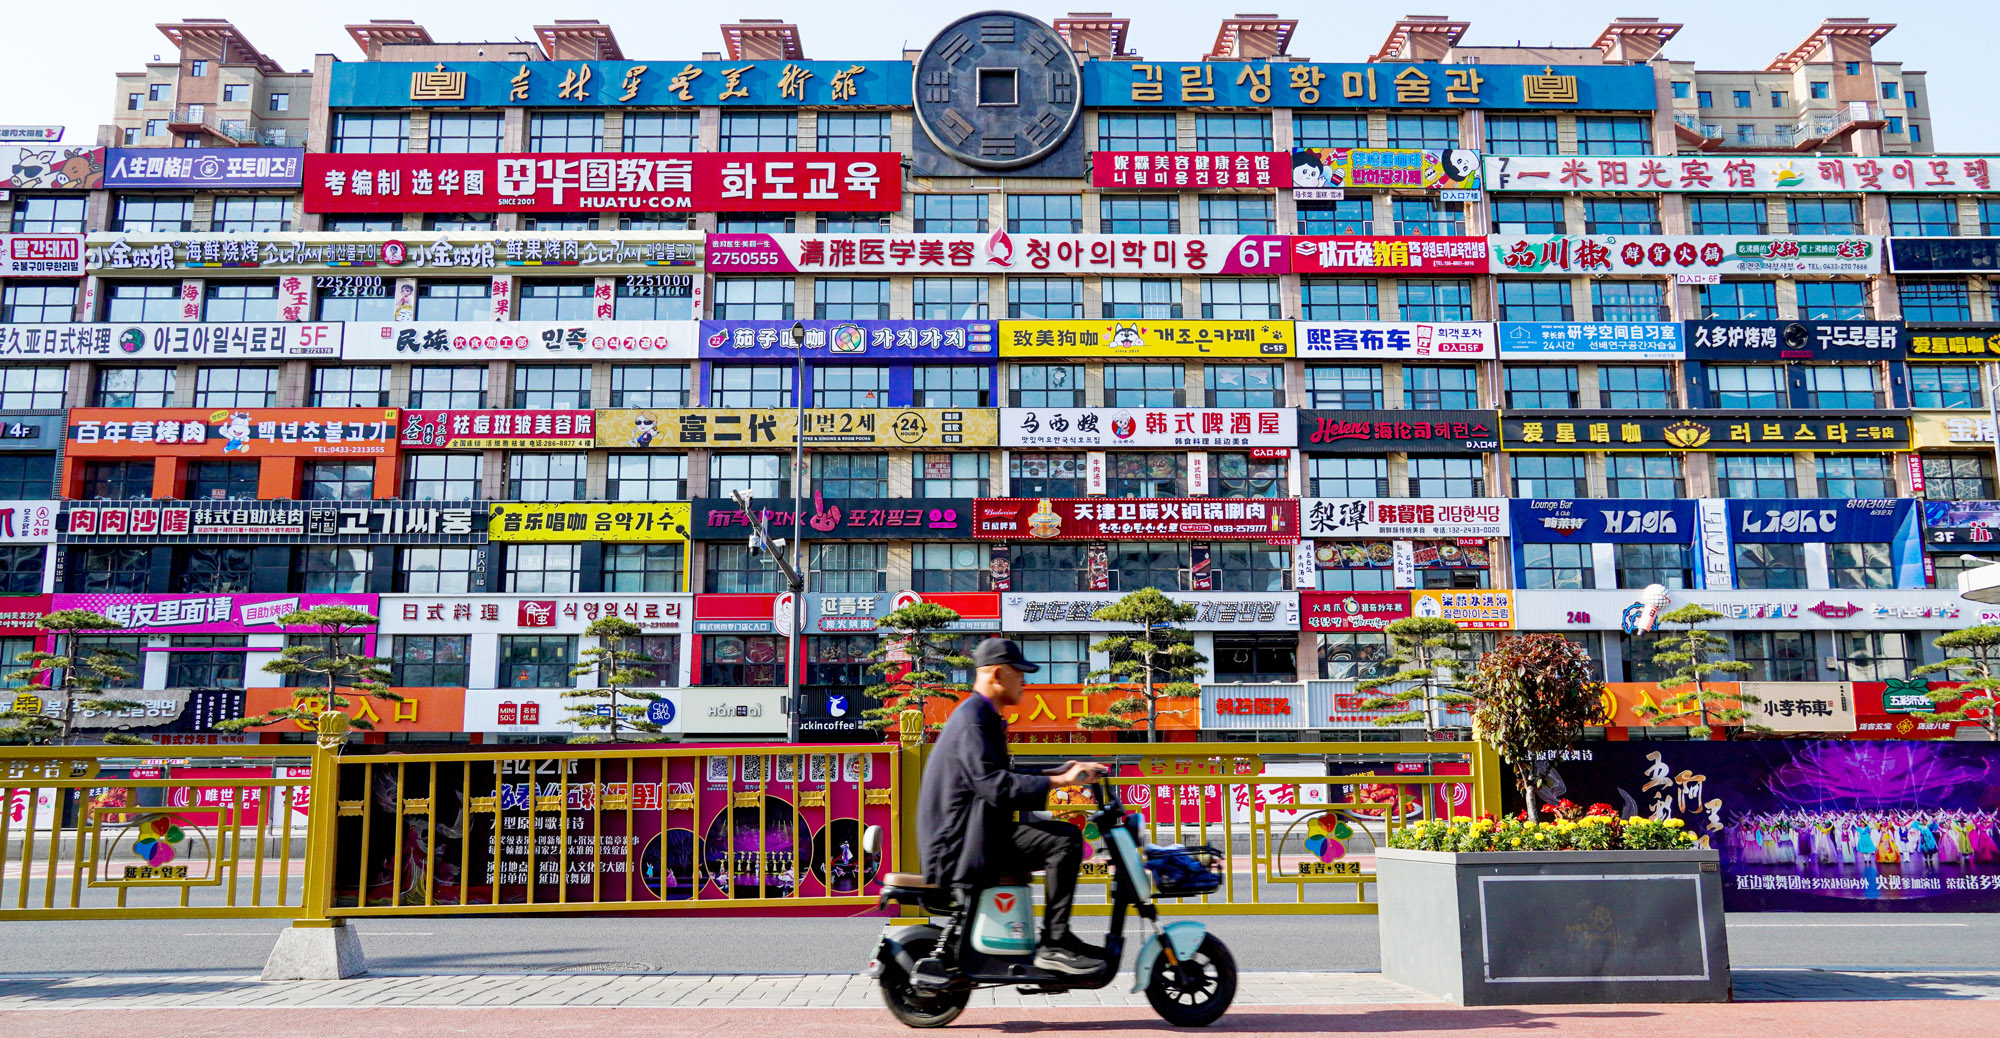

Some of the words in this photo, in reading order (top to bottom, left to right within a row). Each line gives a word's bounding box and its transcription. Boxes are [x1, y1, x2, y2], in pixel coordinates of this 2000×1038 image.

[1130, 63, 1484, 104] 길림성황미술관
[111, 157, 182, 179] 人生四格
[226, 157, 286, 178] 포토이즈
[1352, 169, 1422, 186] 반하당카페
[1517, 159, 1756, 189] 一米阳光宾馆
[1818, 159, 1991, 190] 해맞이모텔
[325, 168, 400, 196] 考编制
[412, 168, 484, 196] 选华图
[537, 159, 692, 206] 华图教育
[721, 161, 880, 201] 화도교육
[1114, 171, 1271, 186] 니림미용건강회관
[14, 240, 76, 260] 빨간돼지
[89, 237, 175, 270] 小金姑娘
[185, 240, 258, 262] 海鲜烧烤
[326, 242, 377, 262] 해산물구이
[411, 236, 496, 269] 小金姑娘
[506, 238, 579, 260] 鲜果烤肉
[644, 242, 696, 261] 과일불고기
[712, 252, 779, 265] 2750555
[798, 238, 975, 269] 清雅医学美容
[1026, 238, 1208, 271] 청아의학미용
[1239, 240, 1284, 266] 6F
[1502, 238, 1613, 272] 品川椒
[12, 261, 79, 272] 숯불구이무한리필
[316, 276, 382, 288] 2252000
[626, 275, 691, 288] 2251000
[183, 284, 199, 320] 海鲜
[282, 276, 309, 321] 帝王蟹
[492, 280, 510, 315] 鲜果
[595, 283, 612, 319] 烤肉
[153, 326, 287, 354] 아크아일식료리
[299, 326, 328, 346] 5F
[396, 328, 450, 353] 民族
[454, 336, 529, 350] 饮食加工部
[541, 327, 588, 352] 민족
[733, 327, 827, 350] 茄子唱咖
[871, 327, 966, 350] 가지가지
[1013, 329, 1099, 347] 致美狗咖
[1153, 328, 1256, 353] 개조은카페
[1307, 328, 1412, 351] 熙客布车
[1541, 331, 1566, 341] 学长的
[1566, 325, 1677, 340] 研学空间自习室
[1694, 326, 1776, 350] 久多炉烤鸡
[1816, 326, 1897, 350] 구도로통닭
[1542, 341, 1576, 351] 24시간
[1912, 336, 1985, 354] 爱星唱咖
[9, 422, 31, 438] 4F
[75, 420, 206, 445] 百年草烤肉
[257, 420, 387, 444] 백년초불고기
[453, 413, 591, 435] 祛痘斑皱美容院
[679, 413, 776, 442] 富二代
[793, 411, 876, 435] 재벌2세
[900, 418, 919, 431] 24
[1020, 412, 1101, 435] 马西嫂
[1145, 411, 1280, 436] 韩式啤酒屋
[1374, 422, 1432, 439] 海伦司
[1434, 422, 1490, 439] 헤런스
[1522, 422, 1641, 445] 爱星唱咖
[1730, 422, 1848, 444] 러브스타
[1856, 426, 1895, 440] 二号店
[1174, 437, 1210, 445] 韩食料理
[1214, 437, 1249, 445] 延边美食
[1466, 441, 1498, 449] D入口4F
[984, 508, 1018, 517] Budweiser
[1074, 502, 1265, 521] 天津卫碳火铜锅涮肉
[1377, 503, 1435, 524] 韩餐馆
[1437, 504, 1500, 524] 리당한식당
[1531, 500, 1558, 511] Lounge
[1559, 499, 1573, 510] Bar
[1846, 499, 1897, 509] 하이라이트
[34, 519, 50, 527] 入口
[70, 508, 188, 534] 肉肉沙隆
[195, 508, 304, 525] 韩式自助烤肉
[339, 507, 472, 536] 고기싸롱
[504, 511, 586, 532] 音乐唱咖
[596, 511, 674, 532] 음악가수
[849, 508, 922, 527] 포차핑크
[1600, 510, 1678, 534] High
[1741, 509, 1837, 534] Light
[1213, 524, 1268, 533] 0433-2579777
[1934, 531, 1955, 543] 3F
[1007, 596, 1022, 605] 2F
[105, 596, 232, 629] 烤友里面请
[247, 602, 293, 621] 自助烤肉
[402, 602, 499, 622] 日式料理
[562, 602, 682, 621] 식영일식료리
[1443, 608, 1509, 619] 칠린아이스크림
[1567, 610, 1591, 624] 24h
[523, 707, 537, 715] 名创
[653, 702, 670, 711] CHA
[486, 861, 530, 873] 演出地点
[539, 861, 635, 873] 延边人文化宫大剧场
[486, 873, 529, 885] 演出单位
[1737, 875, 1869, 891] 延边歌舞团曾多次赴国内外
[1875, 875, 1940, 891] 央视参加演出
